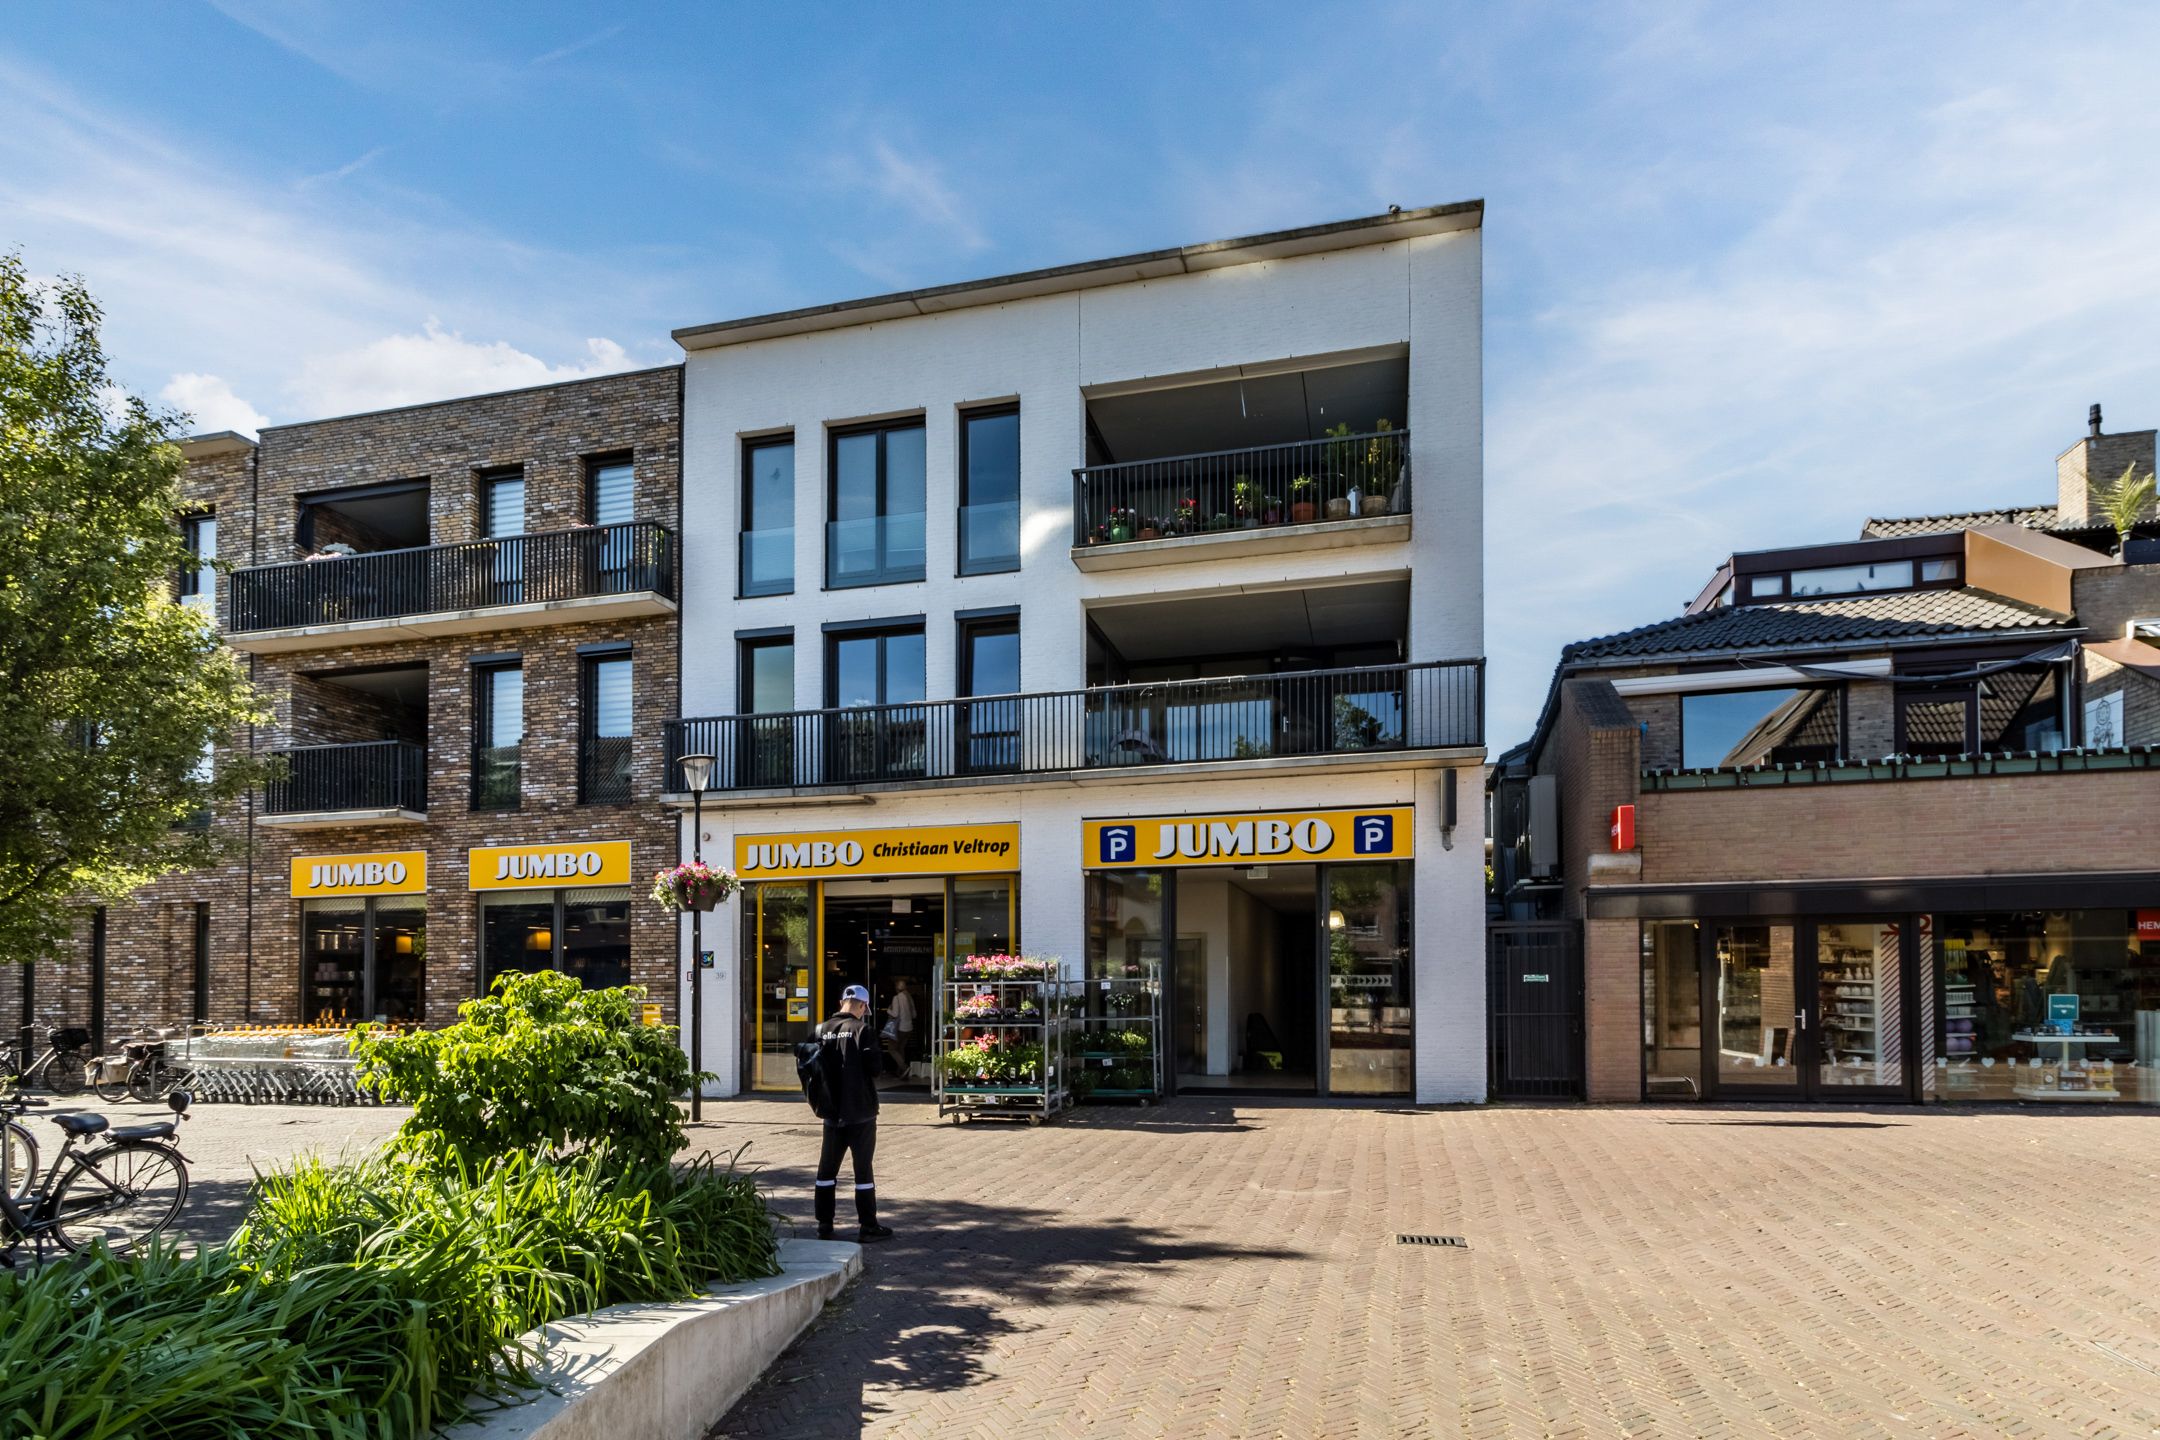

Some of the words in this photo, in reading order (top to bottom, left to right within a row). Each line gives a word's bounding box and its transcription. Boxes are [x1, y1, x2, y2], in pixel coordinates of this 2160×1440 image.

[1152, 818, 1335, 859] JUMBO
[495, 851, 604, 881] JUMBO
[742, 840, 864, 870] JUMBO
[872, 841, 949, 857] Christiaan
[953, 838, 1010, 857] Veltrop
[308, 861, 408, 888] JUMBO
[822, 1031, 853, 1040] elle.com
